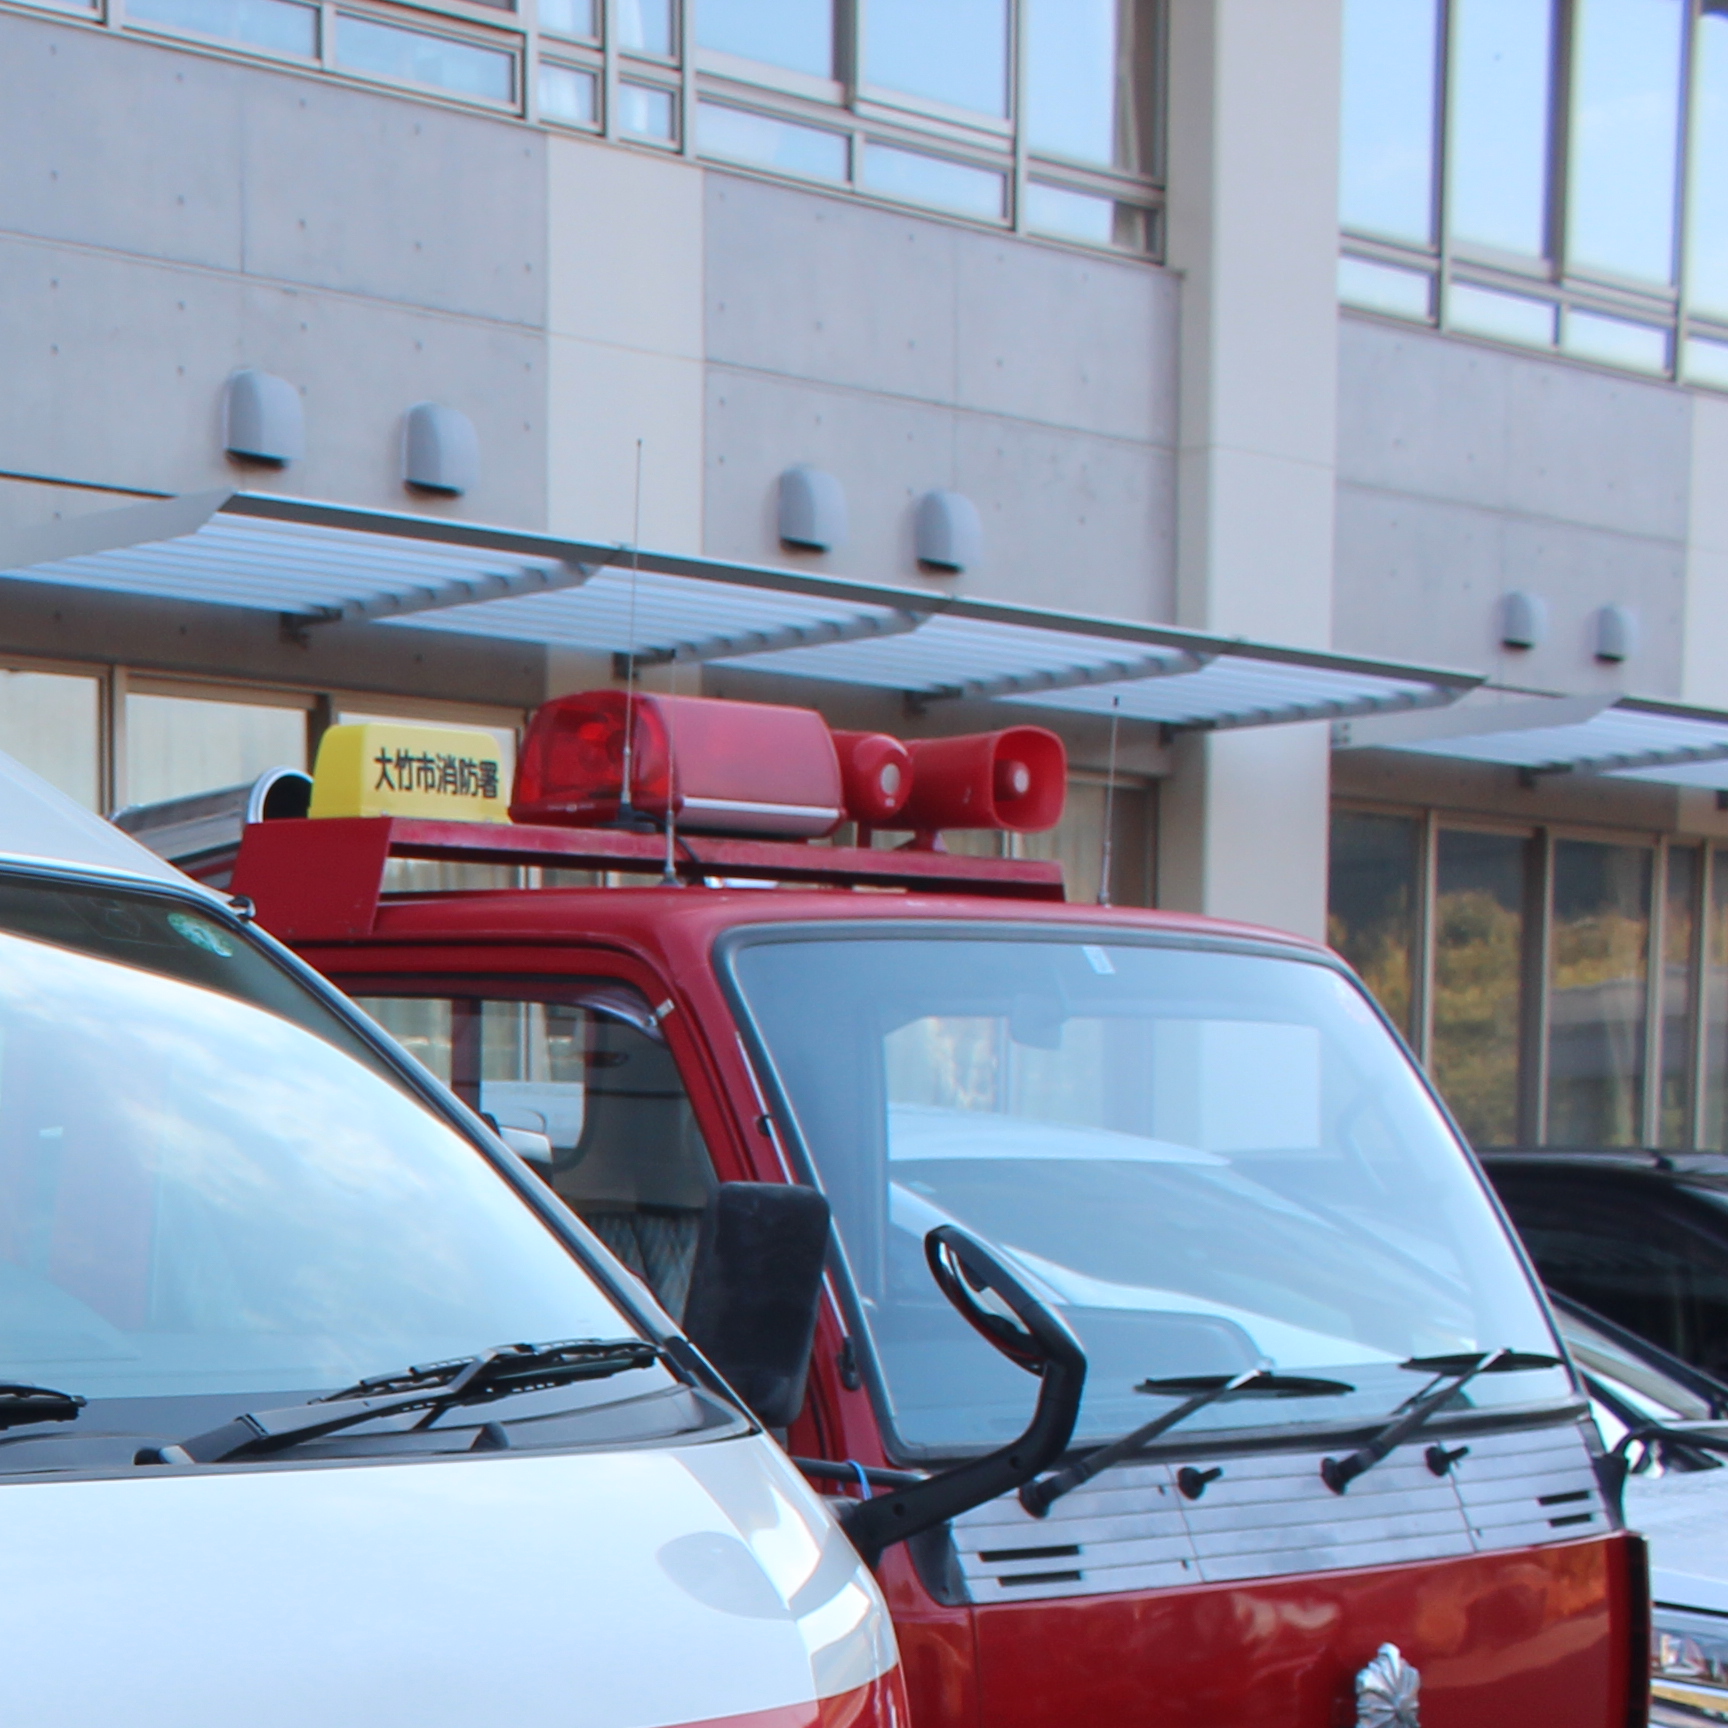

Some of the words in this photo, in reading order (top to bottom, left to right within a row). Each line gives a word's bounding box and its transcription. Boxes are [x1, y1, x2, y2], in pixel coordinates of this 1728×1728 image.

[374, 747, 499, 799] 大竹市消防署
